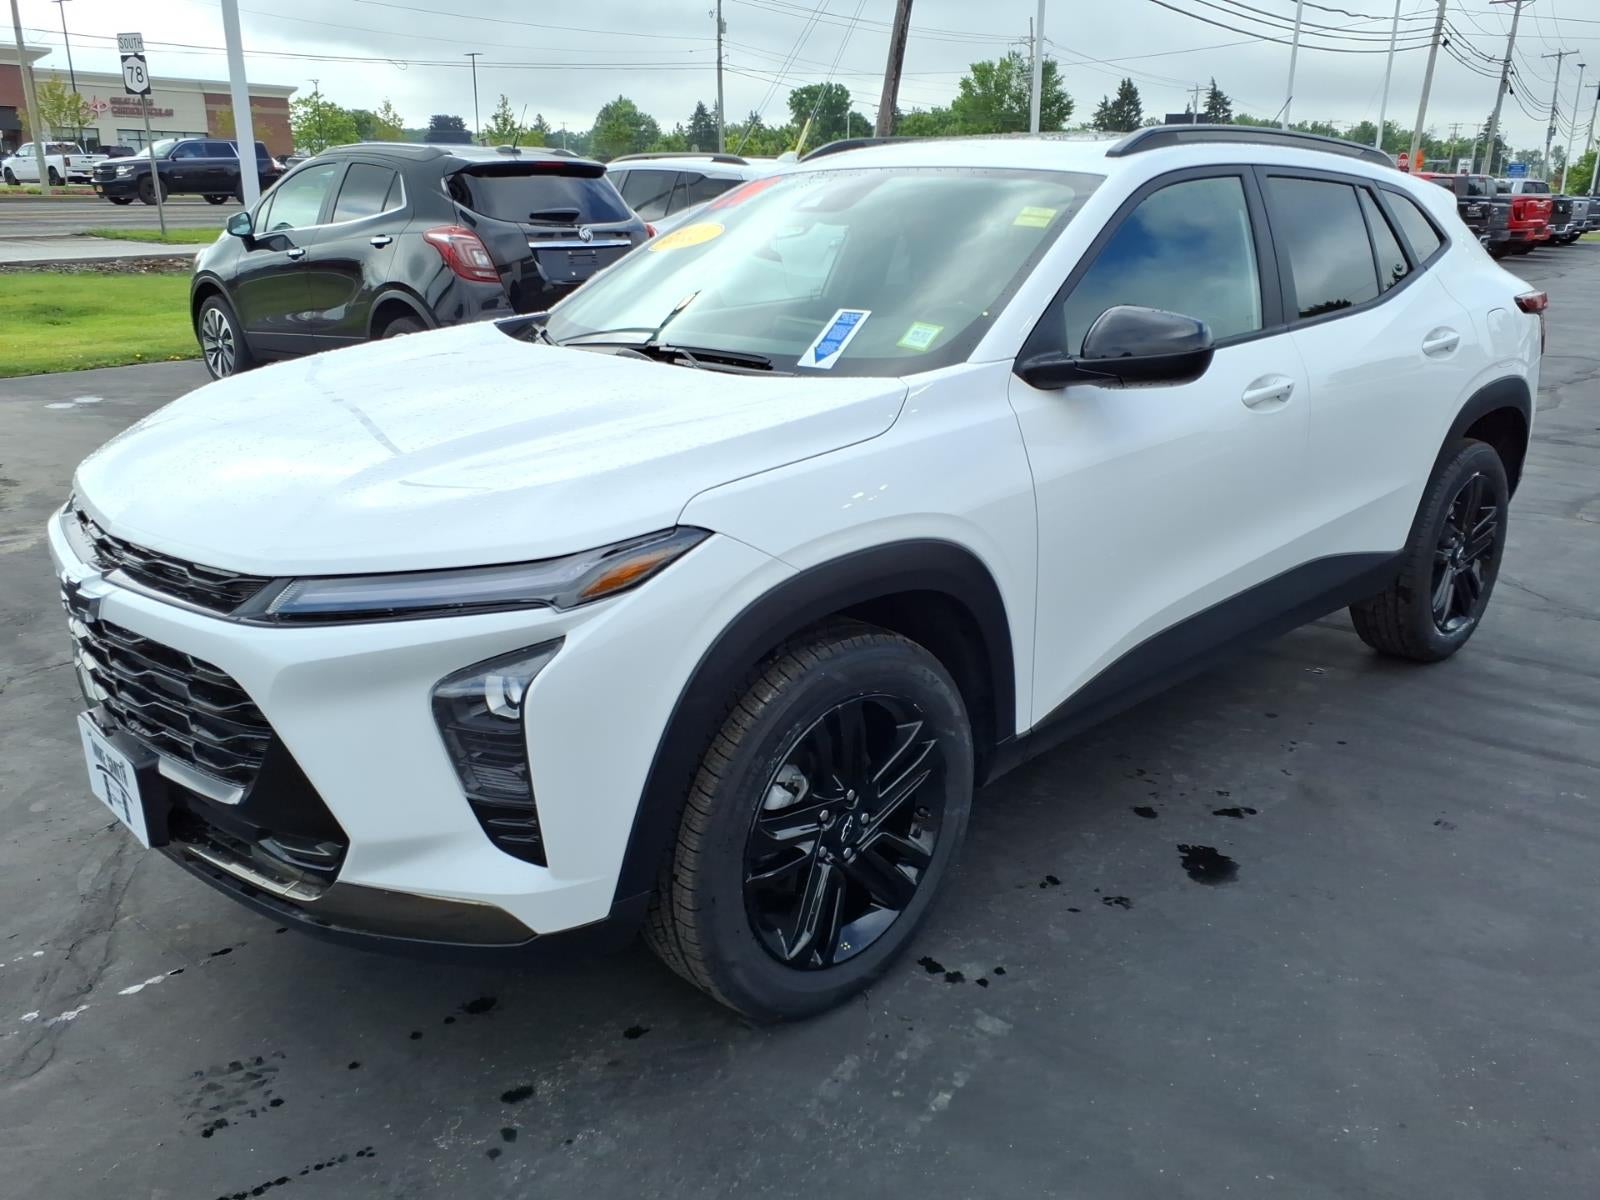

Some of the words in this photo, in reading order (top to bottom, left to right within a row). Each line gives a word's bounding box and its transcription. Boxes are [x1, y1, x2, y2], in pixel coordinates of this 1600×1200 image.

[118, 37, 143, 49] SOUTH
[127, 66, 144, 83] 78
[132, 98, 154, 106] LAES
